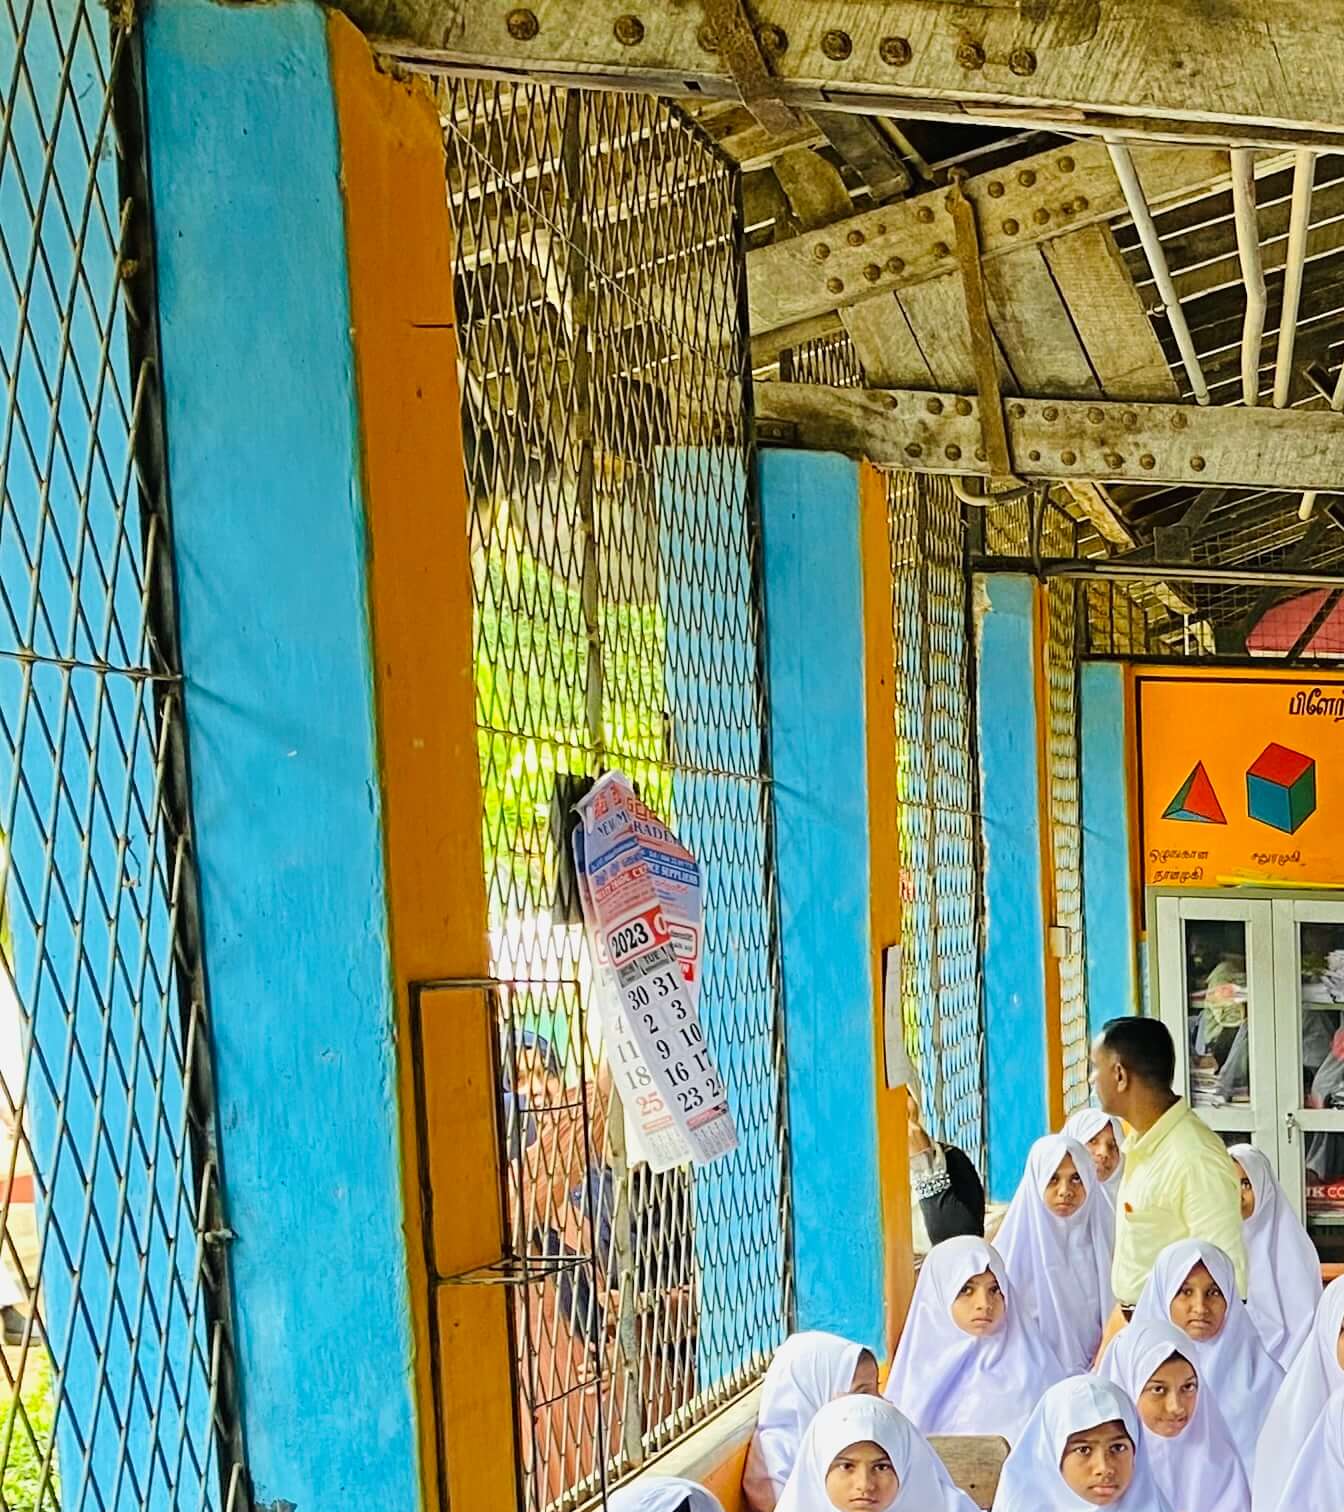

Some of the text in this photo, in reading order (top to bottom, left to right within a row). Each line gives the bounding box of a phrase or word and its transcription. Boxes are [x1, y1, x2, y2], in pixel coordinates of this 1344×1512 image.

[612, 922, 649, 958] 2023
[628, 972, 679, 1011] 30 31
[643, 999, 687, 1034] 2 3
[656, 1022, 702, 1060] 9 10
[625, 1065, 652, 1091] 18
[664, 1061, 690, 1088] 16
[636, 1091, 665, 1116] 25
[677, 1086, 704, 1113] 23
